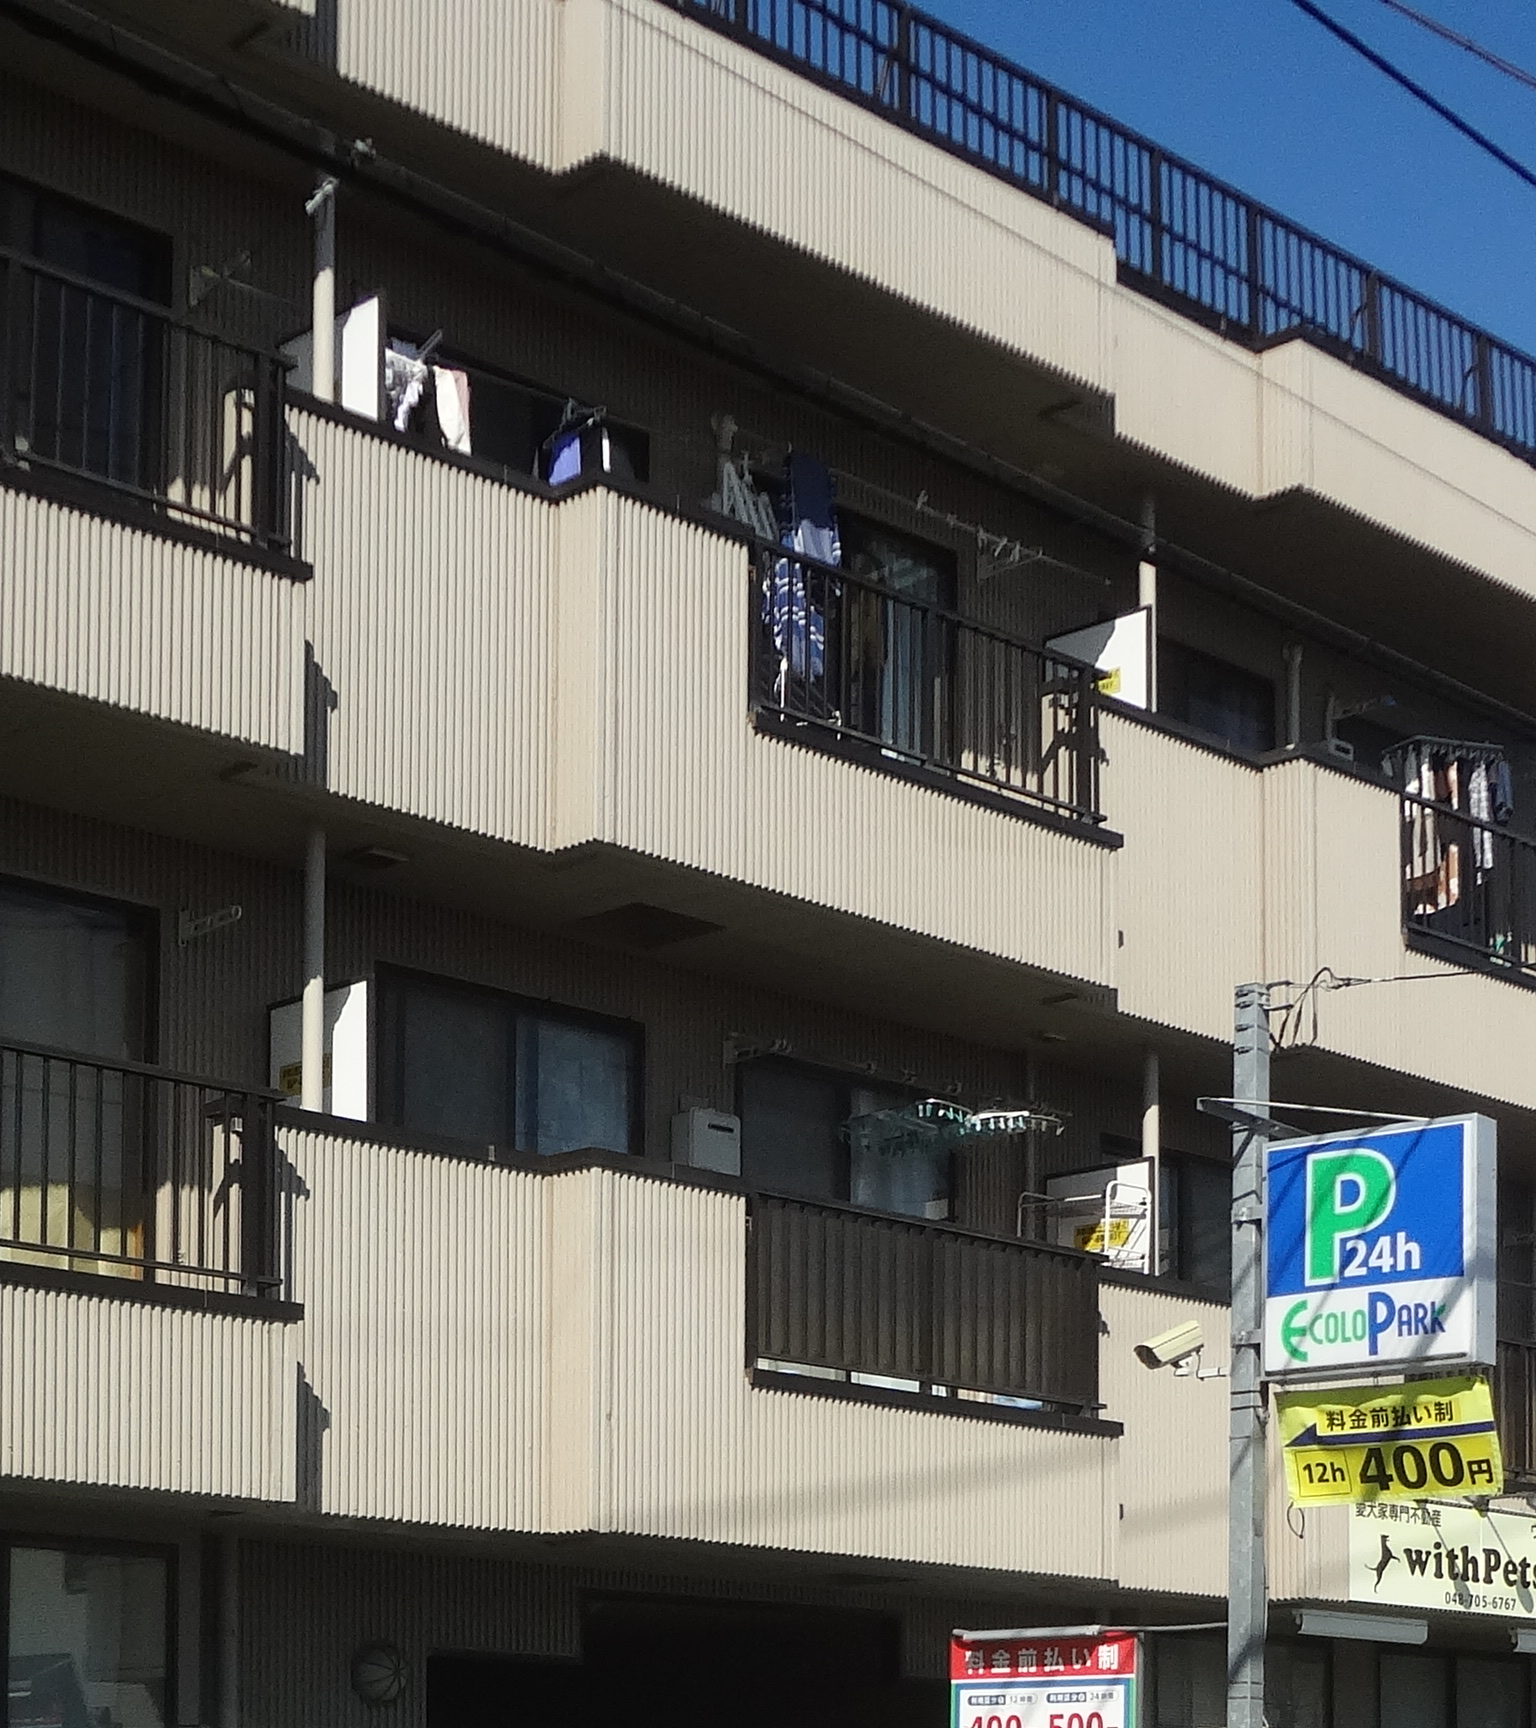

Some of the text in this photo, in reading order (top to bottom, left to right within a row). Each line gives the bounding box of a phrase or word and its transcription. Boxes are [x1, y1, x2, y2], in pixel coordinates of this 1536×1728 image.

[1305, 1148, 1396, 1287] P
[1343, 1231, 1421, 1278] 24h
[1326, 1401, 1453, 1431] 料金前払い制
[1302, 1442, 1494, 1491] 12h 400円
[1355, 1502, 1442, 1527] 愛犬家専門不動産
[1445, 1591, 1516, 1611] 048-705-6767
[965, 1644, 1119, 1674] 料金前払い制
